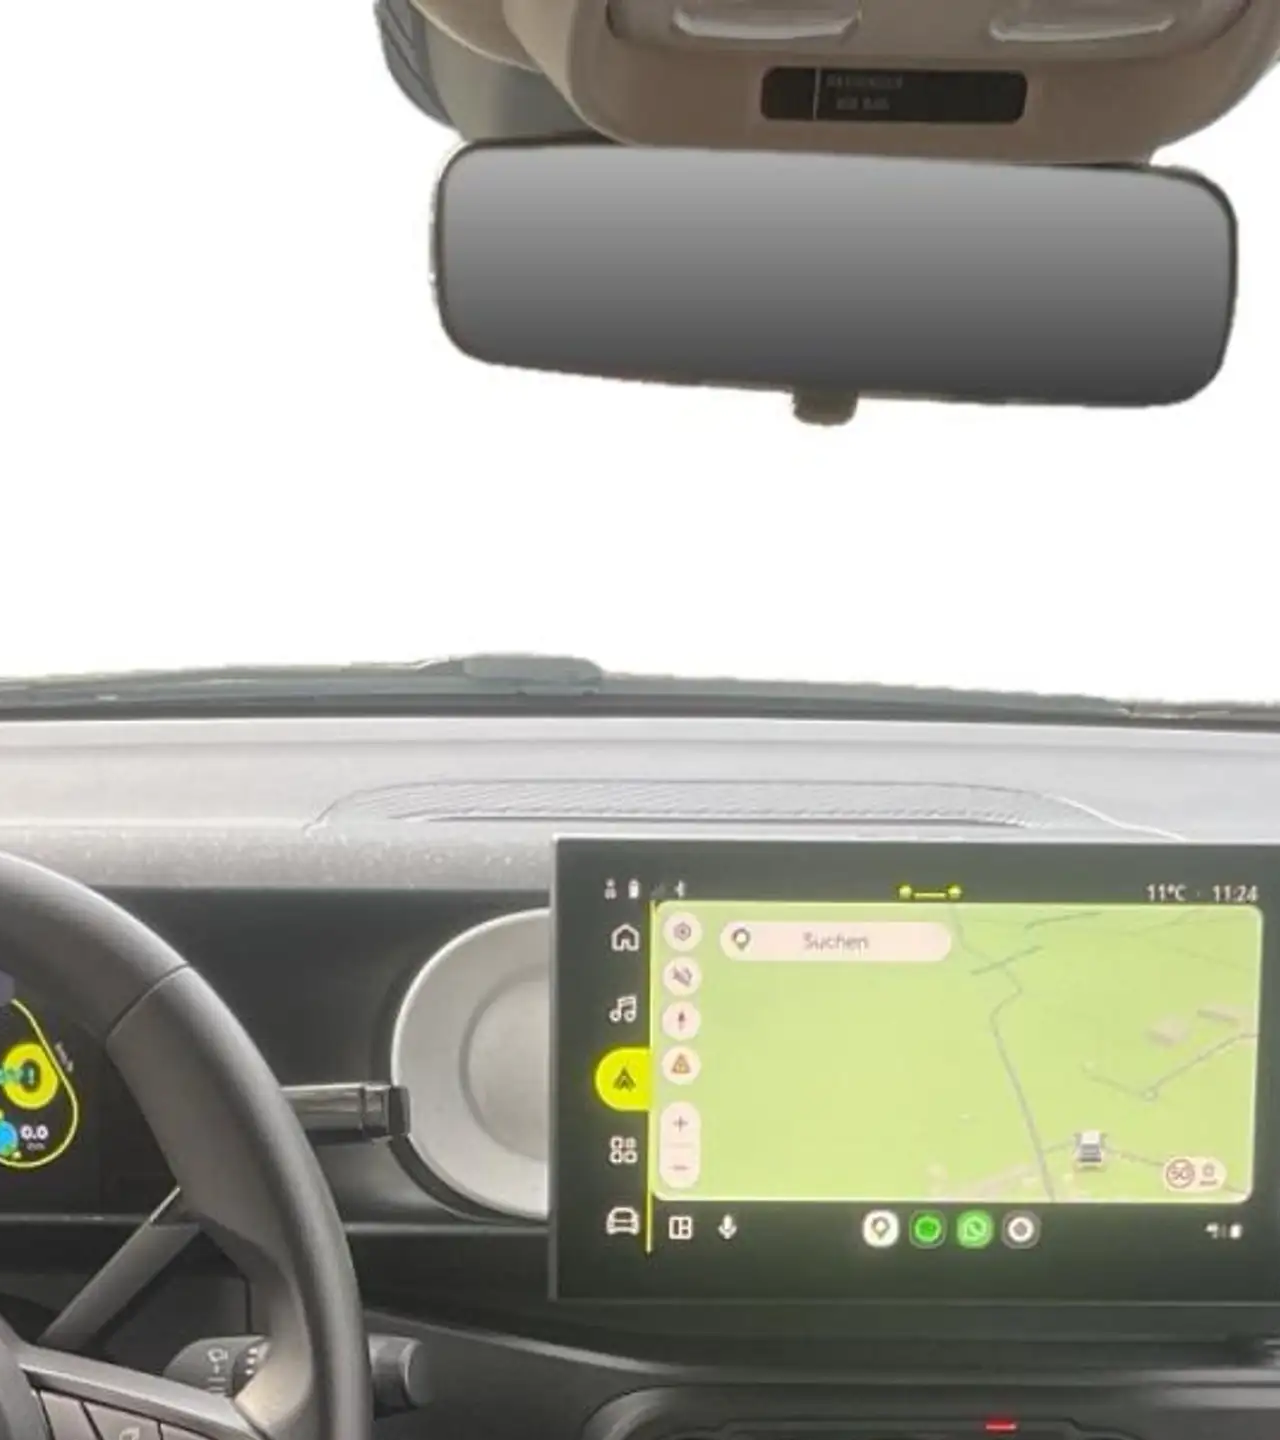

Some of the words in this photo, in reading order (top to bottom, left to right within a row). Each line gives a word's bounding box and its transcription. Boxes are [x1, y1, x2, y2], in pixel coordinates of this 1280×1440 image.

[1145, 883, 1187, 902] 11°C
[1212, 884, 1259, 903] 11:24
[802, 930, 869, 952] Suchen
[21, 1126, 48, 1140] 0.0
